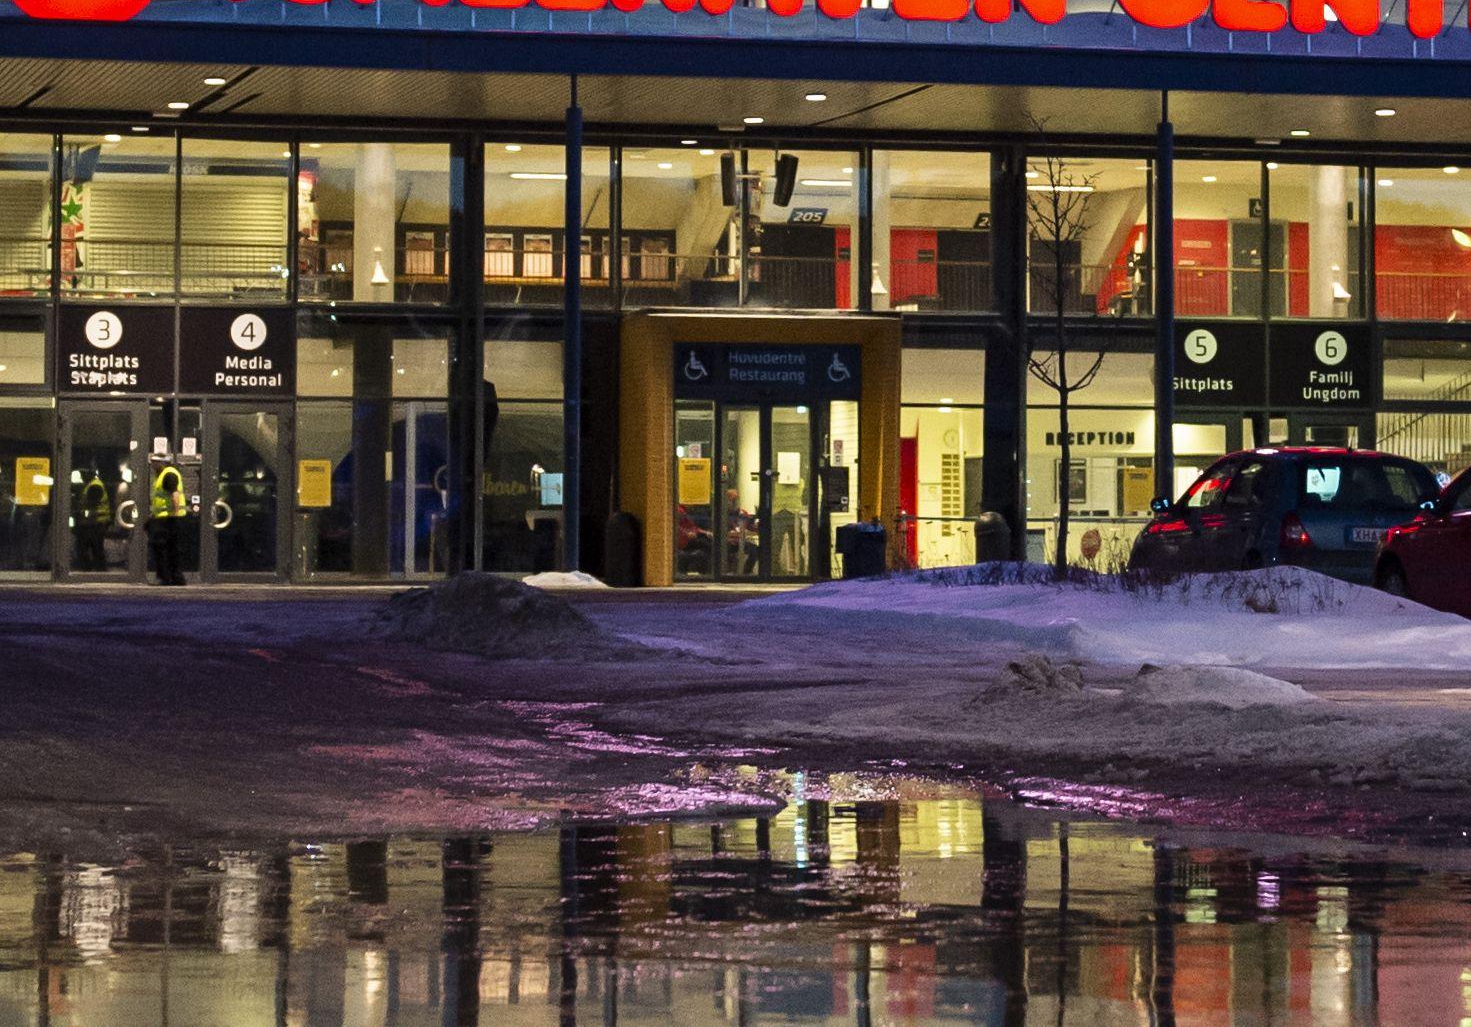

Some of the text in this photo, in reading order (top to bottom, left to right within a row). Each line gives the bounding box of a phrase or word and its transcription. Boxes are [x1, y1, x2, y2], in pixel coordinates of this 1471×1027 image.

[793, 211, 822, 223] 205
[98, 319, 110, 341] 3
[240, 321, 256, 343] 4
[1195, 336, 1207, 357] 5
[1325, 337, 1337, 359] 6
[69, 354, 140, 370] Sittplats
[225, 356, 273, 370] Media
[215, 372, 282, 387] Personal
[729, 368, 806, 385] Restaurang
[1309, 371, 1353, 386] Familj
[1303, 387, 1360, 403] Ungdom
[1045, 431, 1135, 446] RCEPTION
